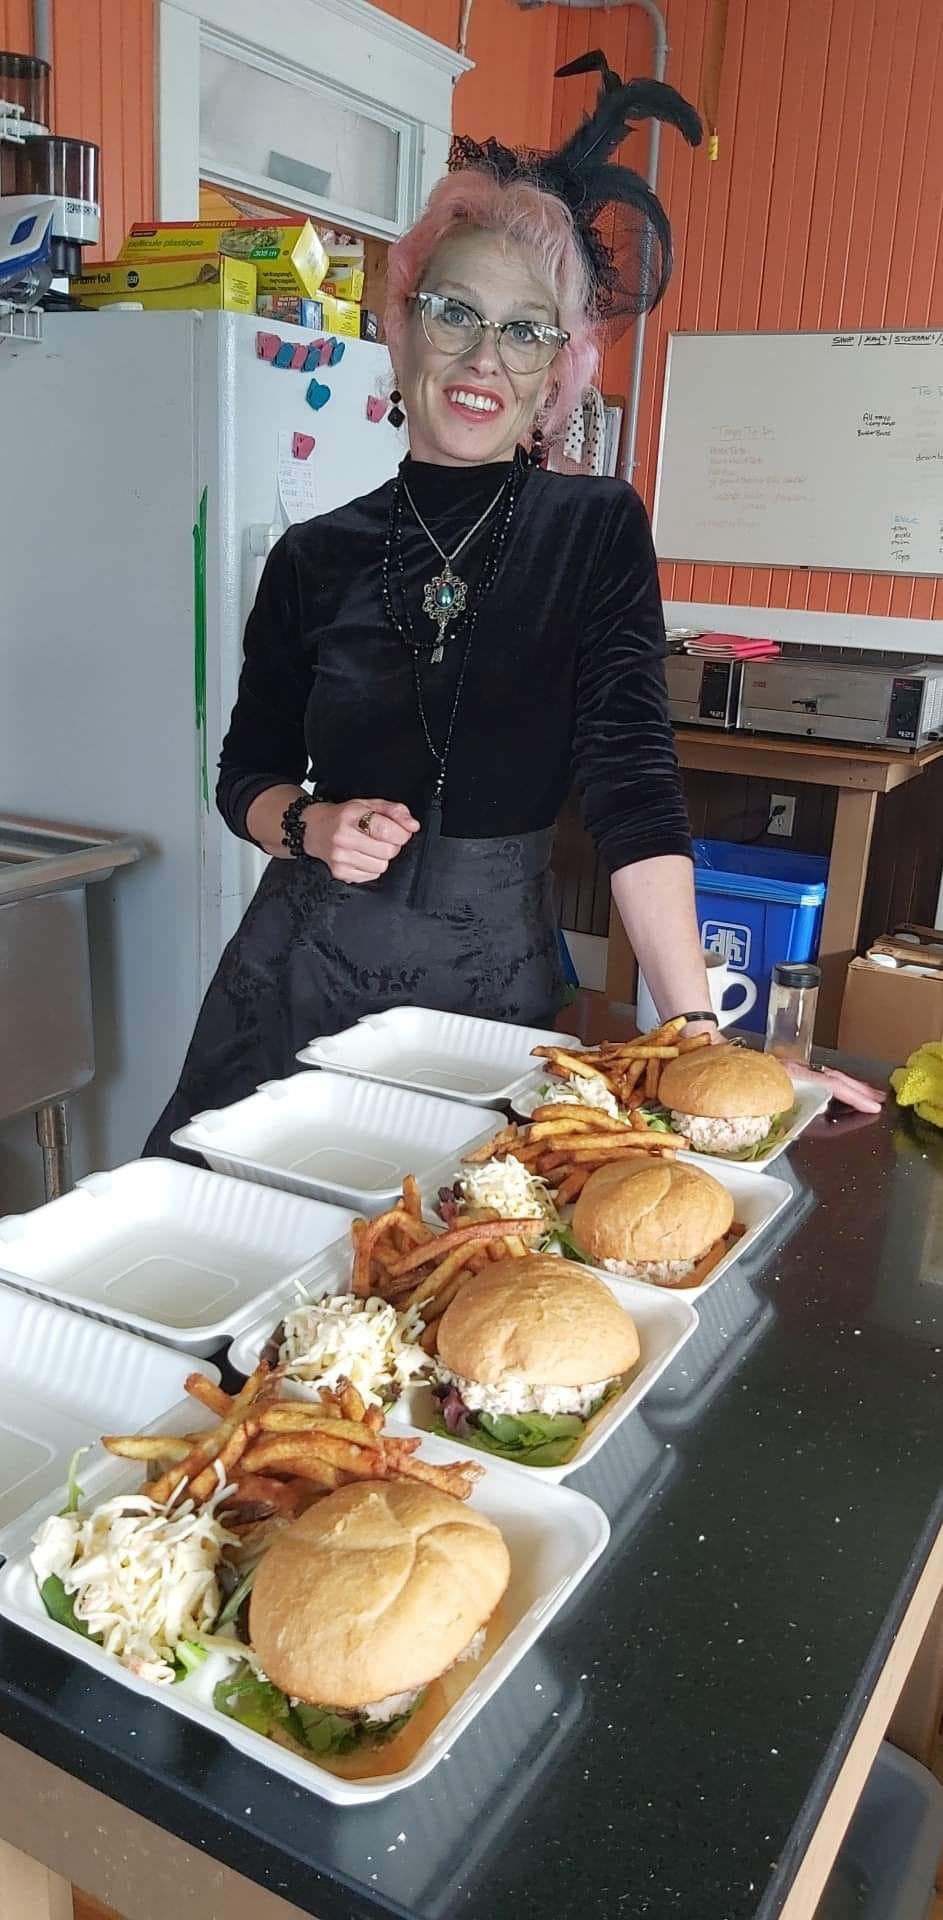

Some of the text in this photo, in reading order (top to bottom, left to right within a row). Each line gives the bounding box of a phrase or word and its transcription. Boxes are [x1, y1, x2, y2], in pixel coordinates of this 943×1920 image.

[127, 239, 204, 249] pellicule plastique
[97, 273, 111, 284] foil
